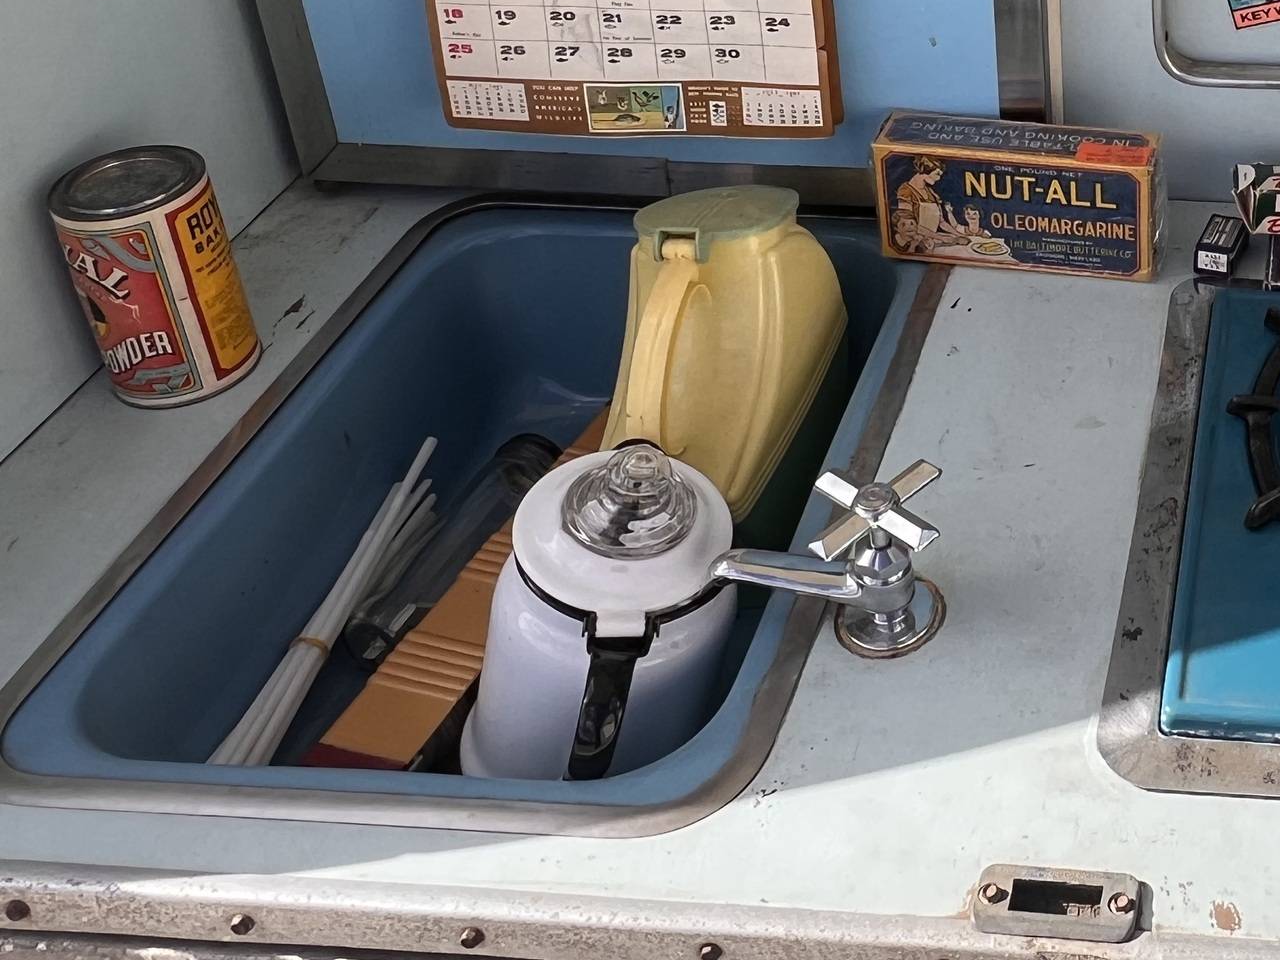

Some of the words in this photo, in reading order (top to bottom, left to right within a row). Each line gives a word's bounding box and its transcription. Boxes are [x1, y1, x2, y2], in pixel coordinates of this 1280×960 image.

[495, 10, 517, 20] 19
[550, 10, 576, 21] 20
[602, 13, 622, 23] 21
[656, 14, 682, 25] 22
[709, 15, 736, 26] 23
[764, 17, 790, 28] 24
[1239, 7, 1271, 24] KEY
[447, 43, 473, 54] 25
[500, 45, 526, 56] 26
[554, 46, 580, 57] 27
[607, 47, 633, 58] 28
[660, 48, 687, 59] 29
[714, 48, 741, 59] 30
[928, 131, 964, 141] AND
[981, 127, 1019, 138] AND
[1025, 131, 1106, 146] COOKING
[993, 165, 1015, 173] ONE
[1020, 167, 1057, 176] POUND
[963, 171, 1118, 210] NUT-ALL
[990, 211, 1137, 241] OLEOMARGARINE
[1026, 240, 1073, 254] BALTIMORE
